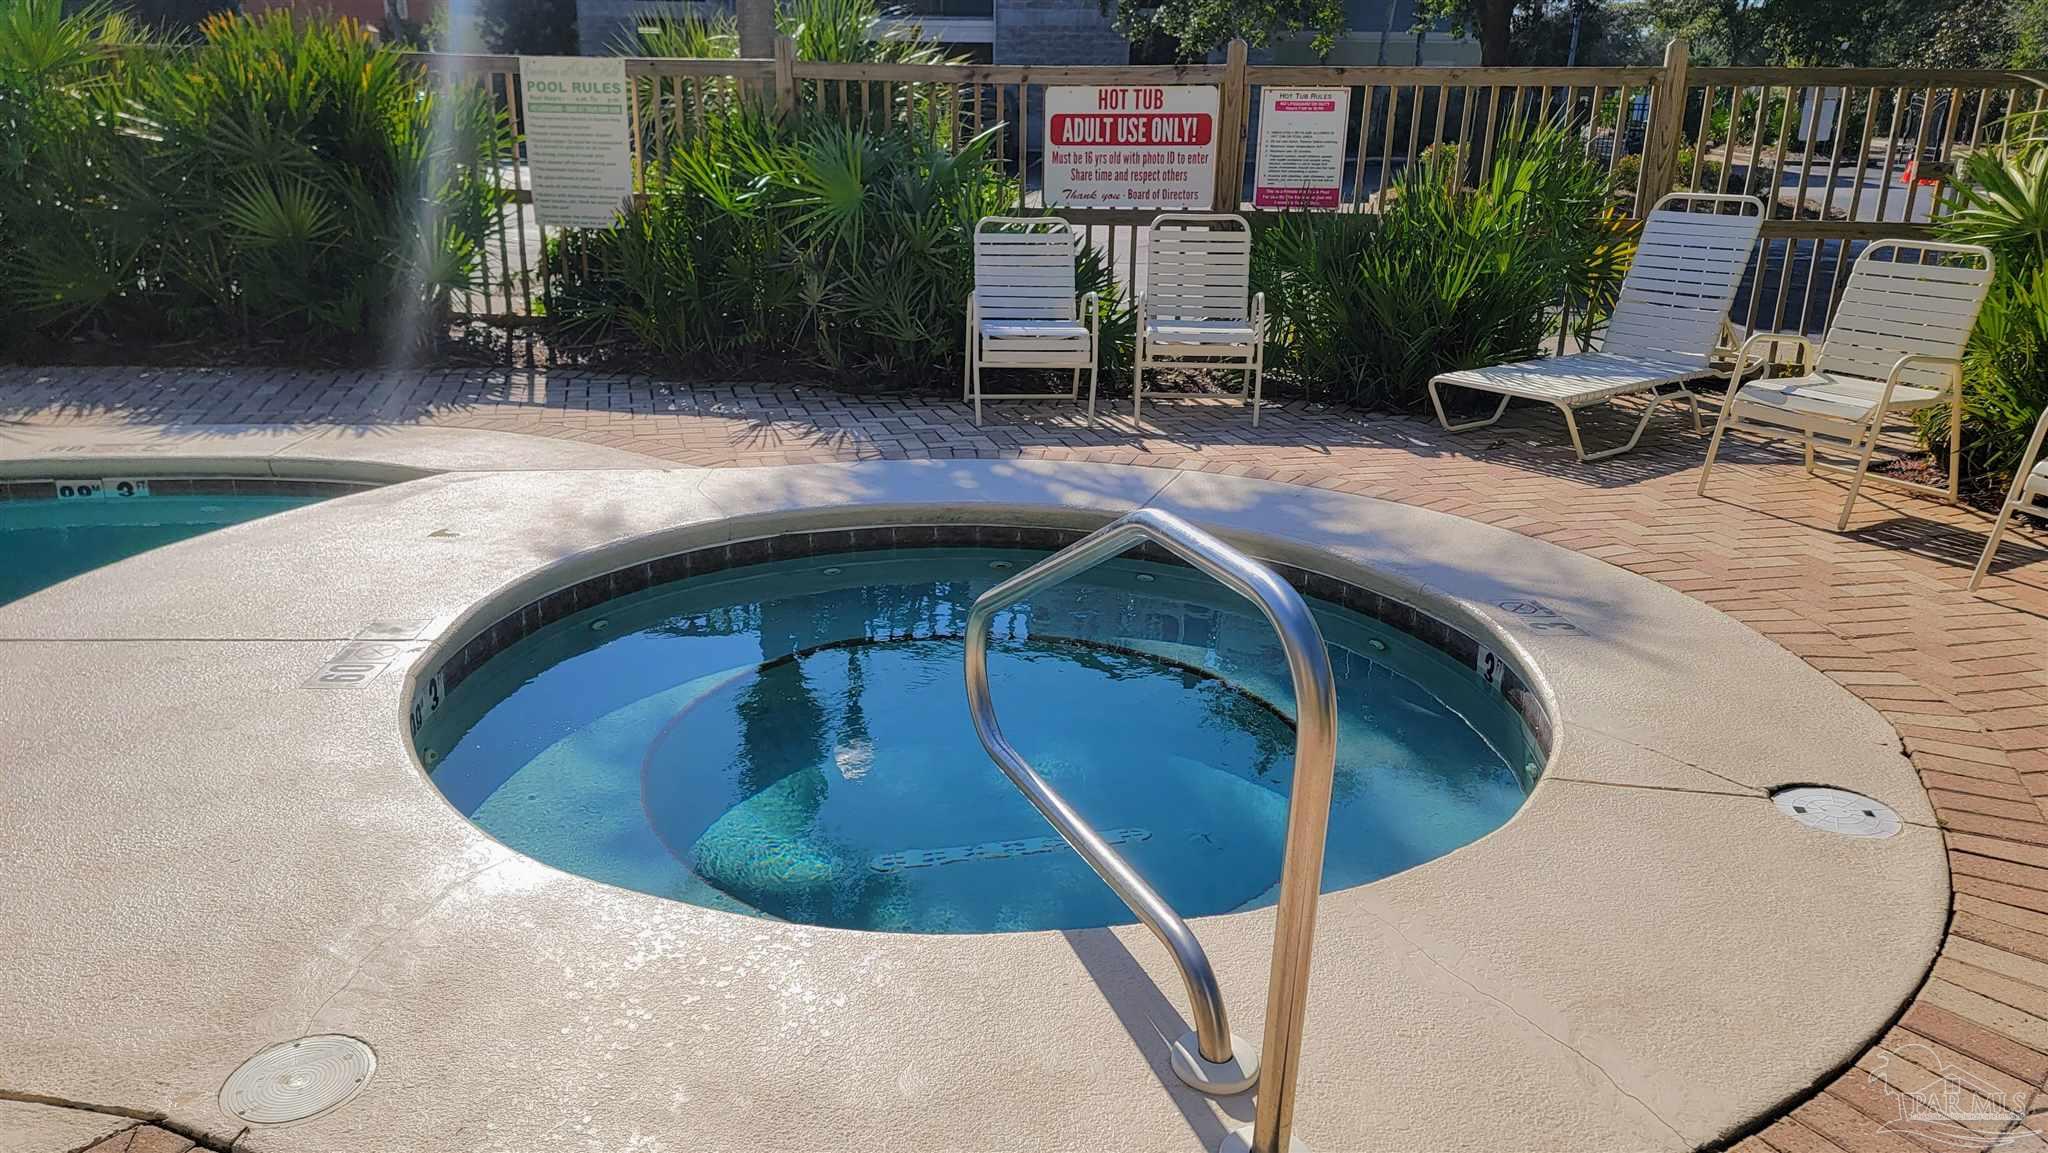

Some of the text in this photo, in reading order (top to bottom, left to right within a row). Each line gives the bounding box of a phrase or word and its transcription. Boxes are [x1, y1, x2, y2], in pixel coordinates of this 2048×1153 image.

[526, 81, 622, 94] POOL RULES
[1098, 89, 1164, 110] HOT TUB
[1062, 117, 1198, 143] ADULT USE ONLY!
[1052, 151, 1209, 167] Must be 16 yrs old with photo ID to enter
[1070, 168, 1188, 184] Share time and respect others
[1062, 188, 1097, 200] Thank
[1101, 193, 1120, 202] you
[1127, 188, 1150, 200] Board
[1152, 189, 1161, 200] of
[1162, 188, 1199, 201] Directors
